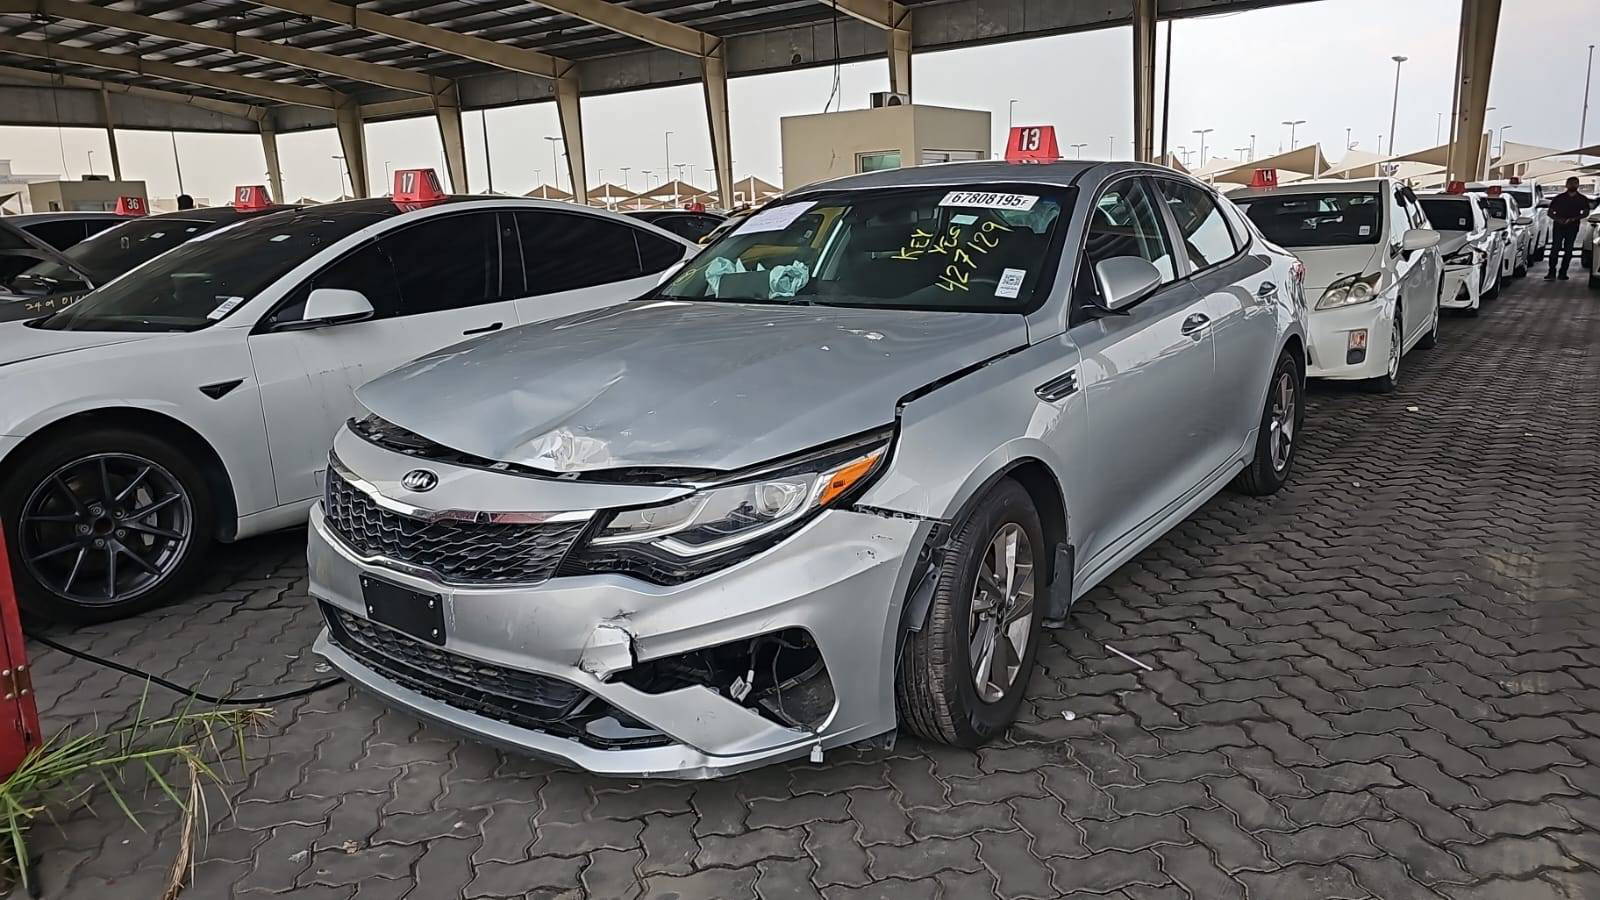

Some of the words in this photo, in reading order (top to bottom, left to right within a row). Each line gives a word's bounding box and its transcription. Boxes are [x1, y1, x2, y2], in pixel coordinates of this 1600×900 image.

[1022, 128, 1040, 151] 13
[402, 172, 414, 193] 17
[1263, 169, 1272, 182] 14
[240, 187, 251, 202] 27
[127, 198, 139, 210] 36
[891, 229, 933, 260] KEY
[404, 471, 431, 488] KIA
